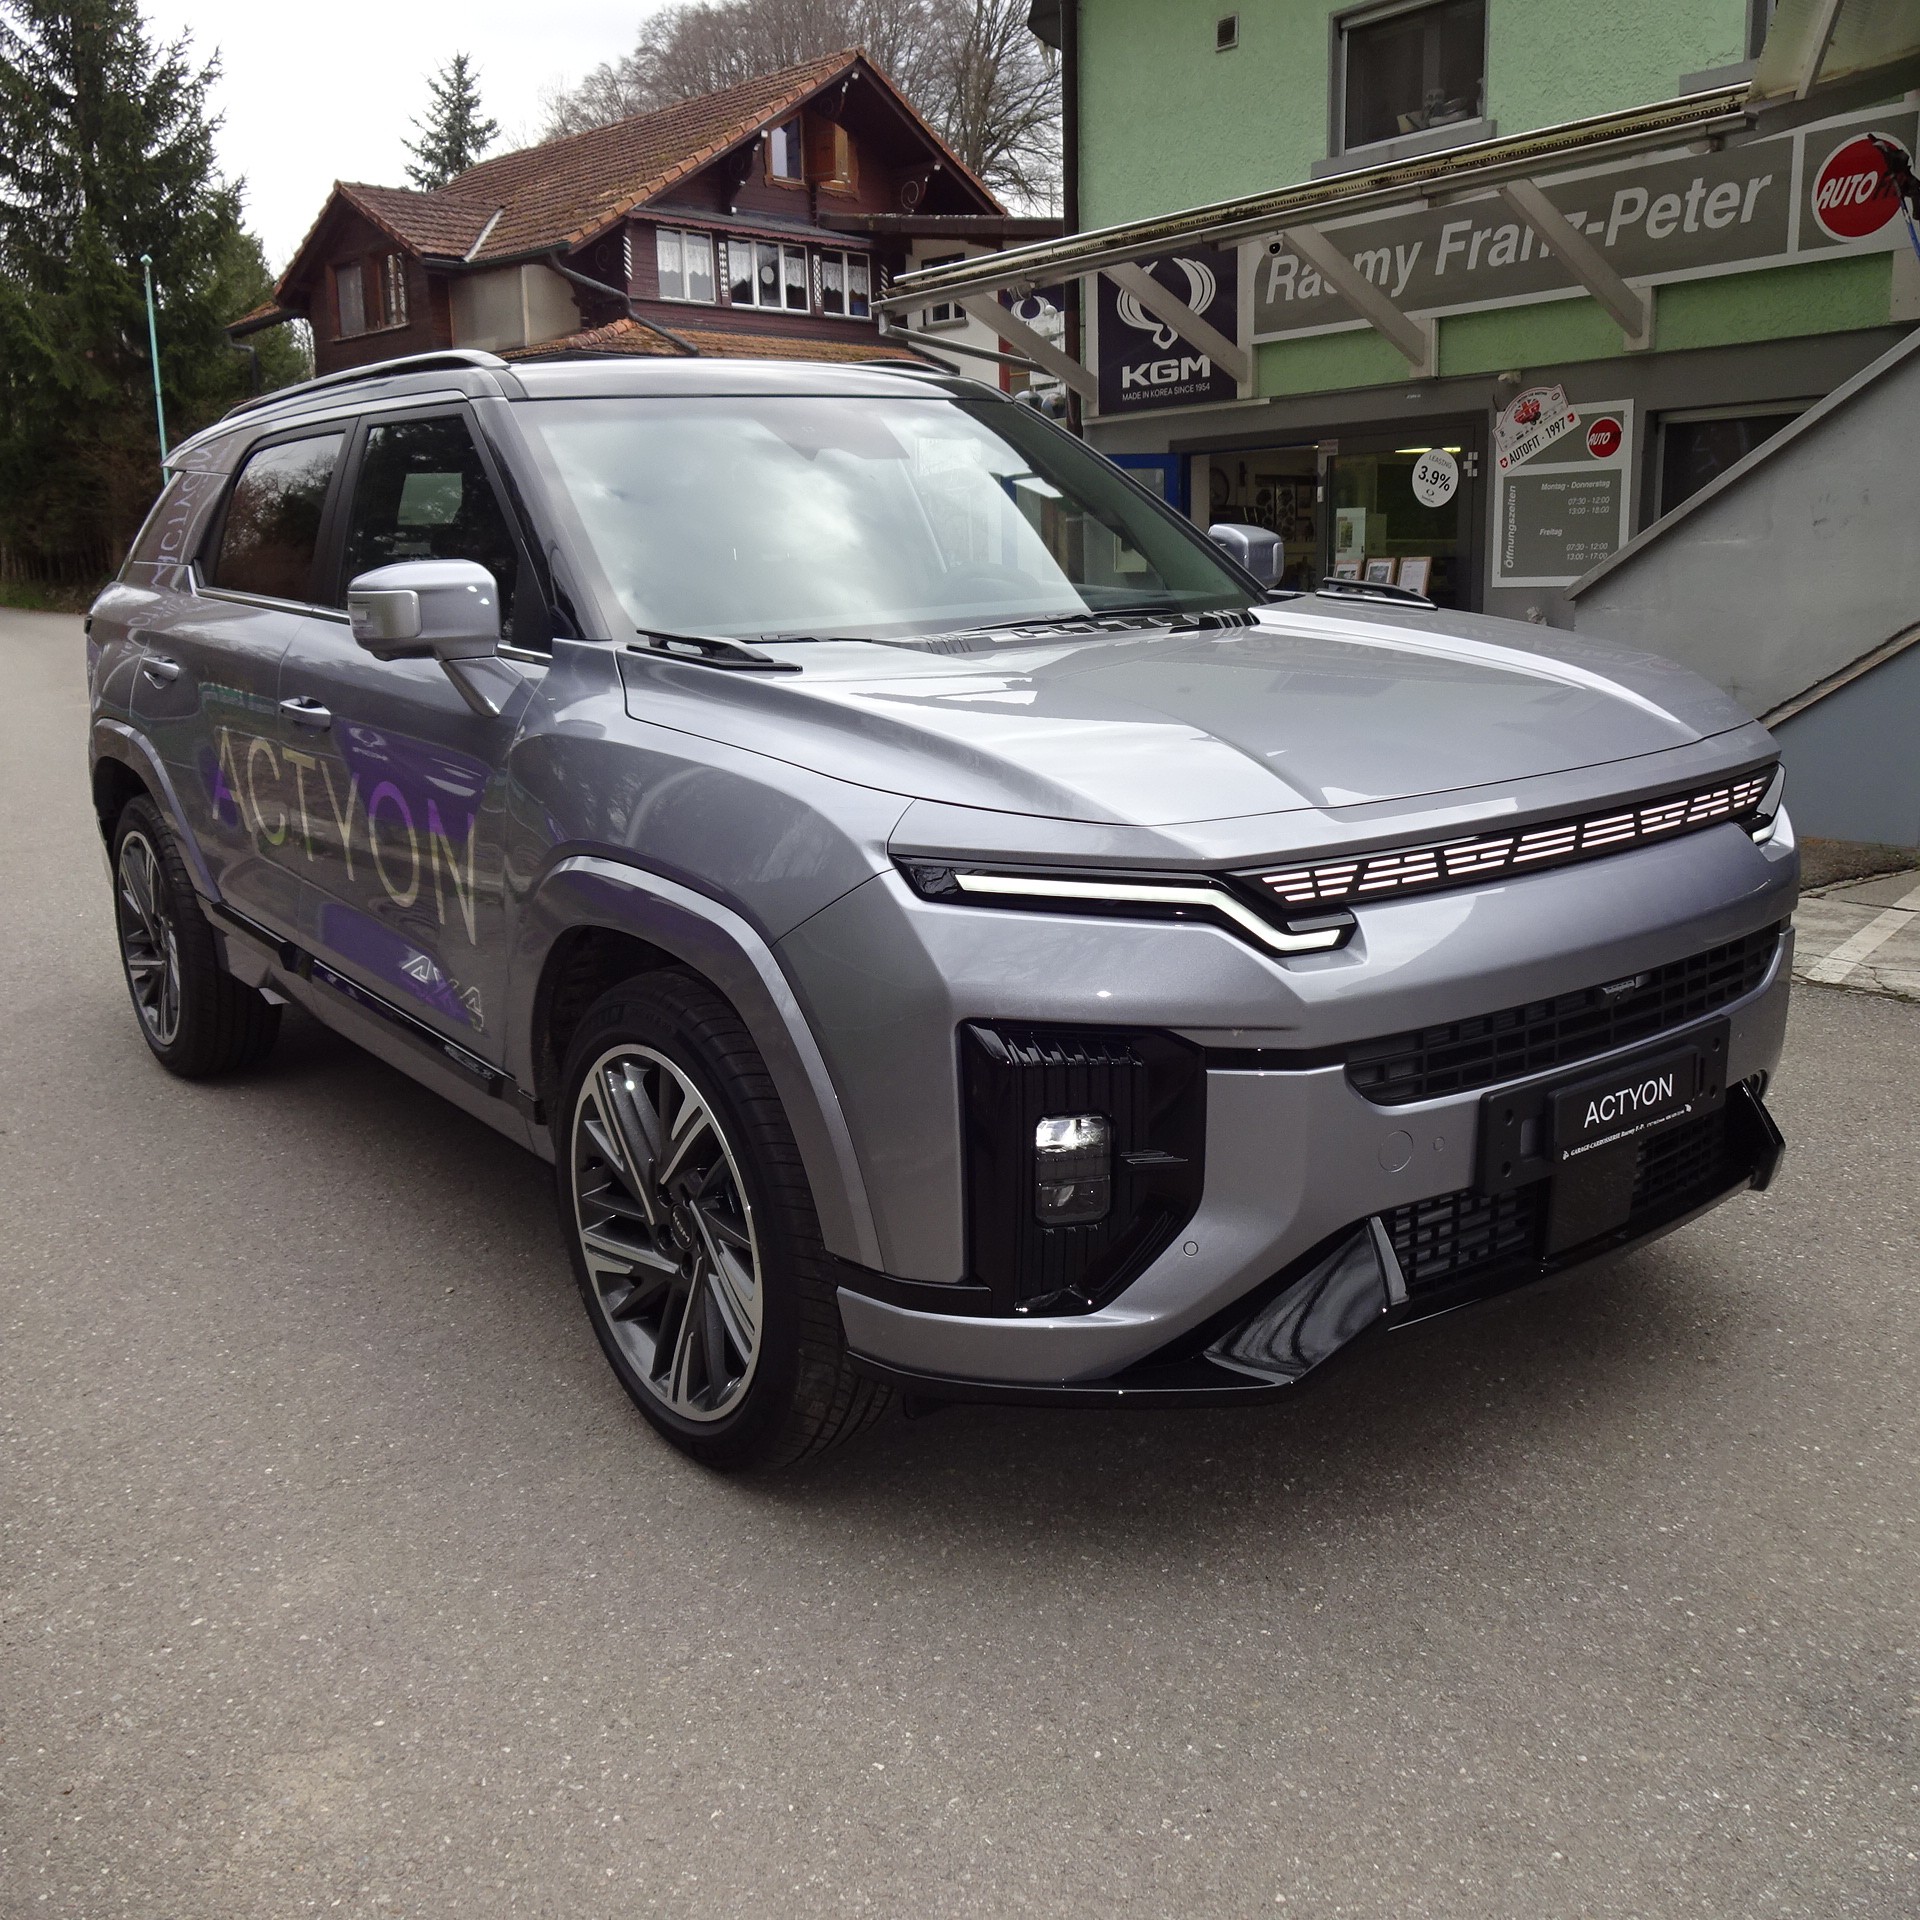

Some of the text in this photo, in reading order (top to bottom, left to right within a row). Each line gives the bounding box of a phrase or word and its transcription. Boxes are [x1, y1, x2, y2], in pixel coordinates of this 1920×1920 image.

[1266, 241, 1423, 304] Ramy
[1122, 354, 1211, 389] KGM
[1122, 382, 1210, 401] MADE IN KOREA SINCE 1954
[1508, 434, 1541, 465] AUTOFIT
[1545, 417, 1567, 439] 1997
[1428, 454, 1452, 469] LEASING
[1418, 465, 1451, 491] 3.9%
[1541, 483, 1566, 491] Montag
[1571, 480, 1611, 489] Donnerstag
[1568, 497, 1586, 505] 07:30
[1592, 496, 1610, 504] 12:00
[1568, 507, 1586, 515] 13:00
[1503, 485, 1517, 568] Öffnungszeiten
[1566, 543, 1584, 551] 07:30
[1590, 542, 1609, 550] 12:00
[213, 725, 477, 946] ACTYON
[1583, 1073, 1674, 1128] ACTYON
